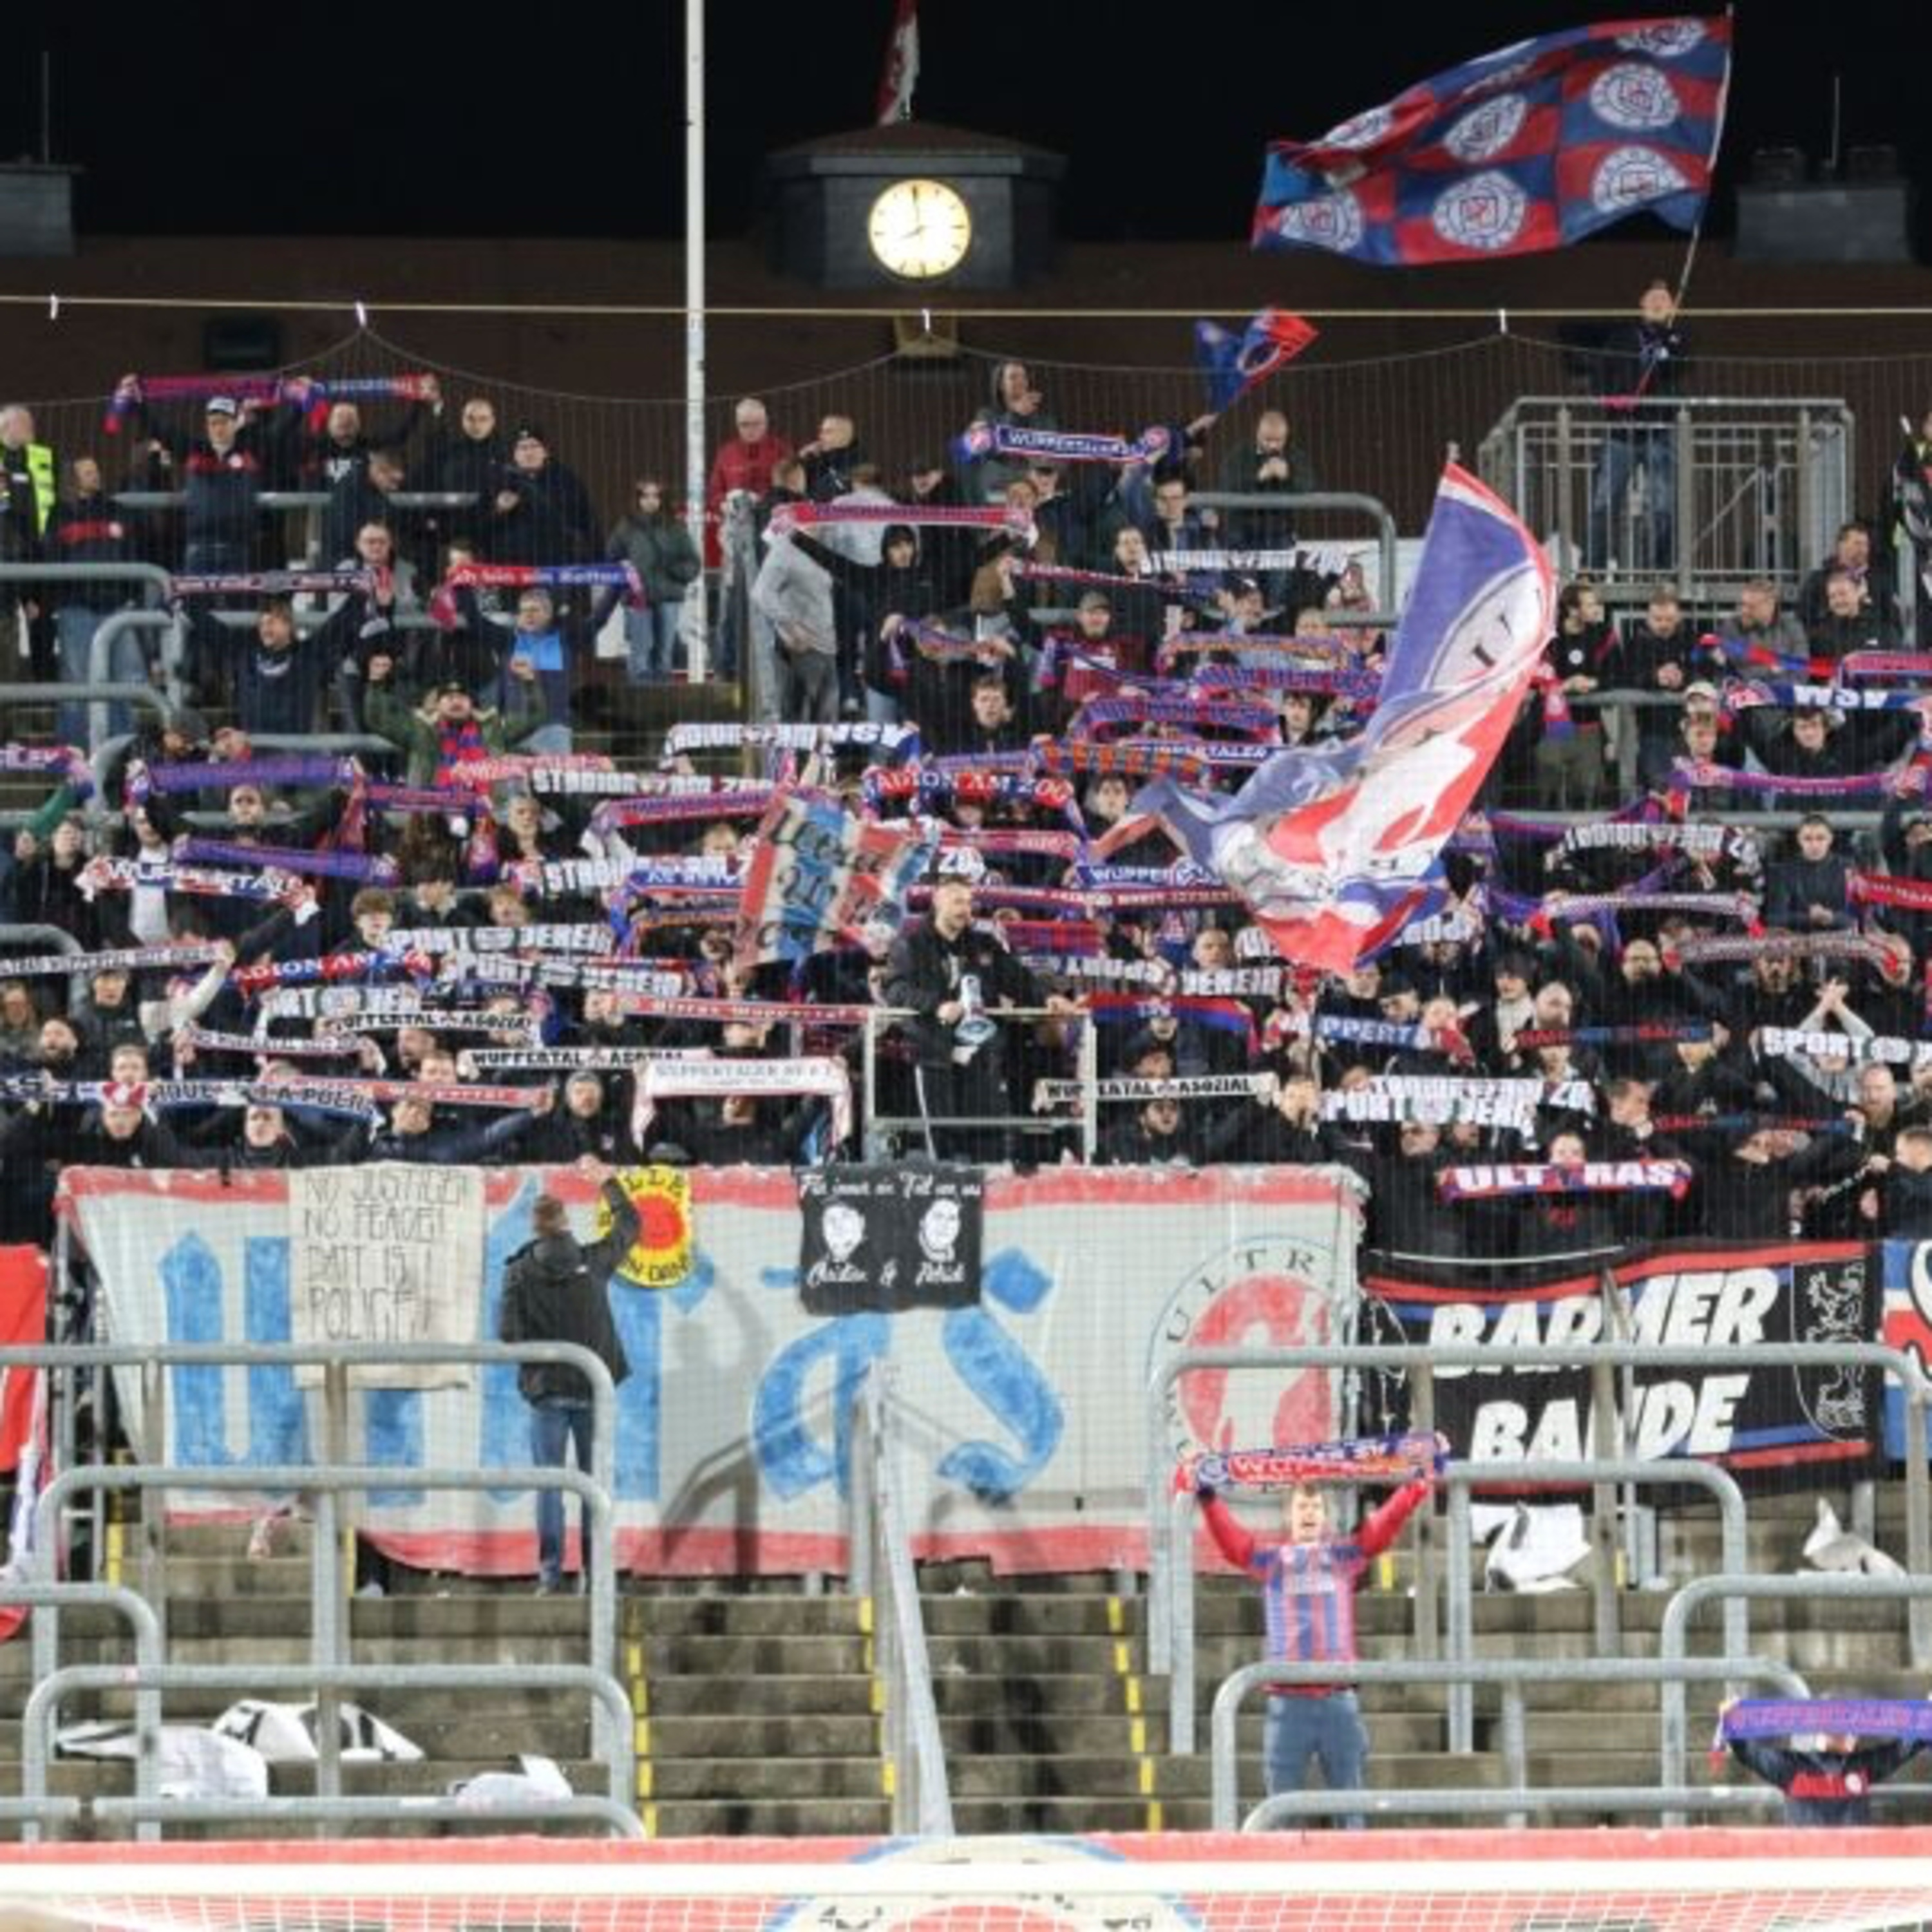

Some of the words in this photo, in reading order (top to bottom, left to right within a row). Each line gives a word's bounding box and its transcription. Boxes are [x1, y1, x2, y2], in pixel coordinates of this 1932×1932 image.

[1793, 685, 1889, 710] WSV
[1046, 1079, 1155, 1097] WUPERTAL
[1423, 1266, 1781, 1379] BARMER
